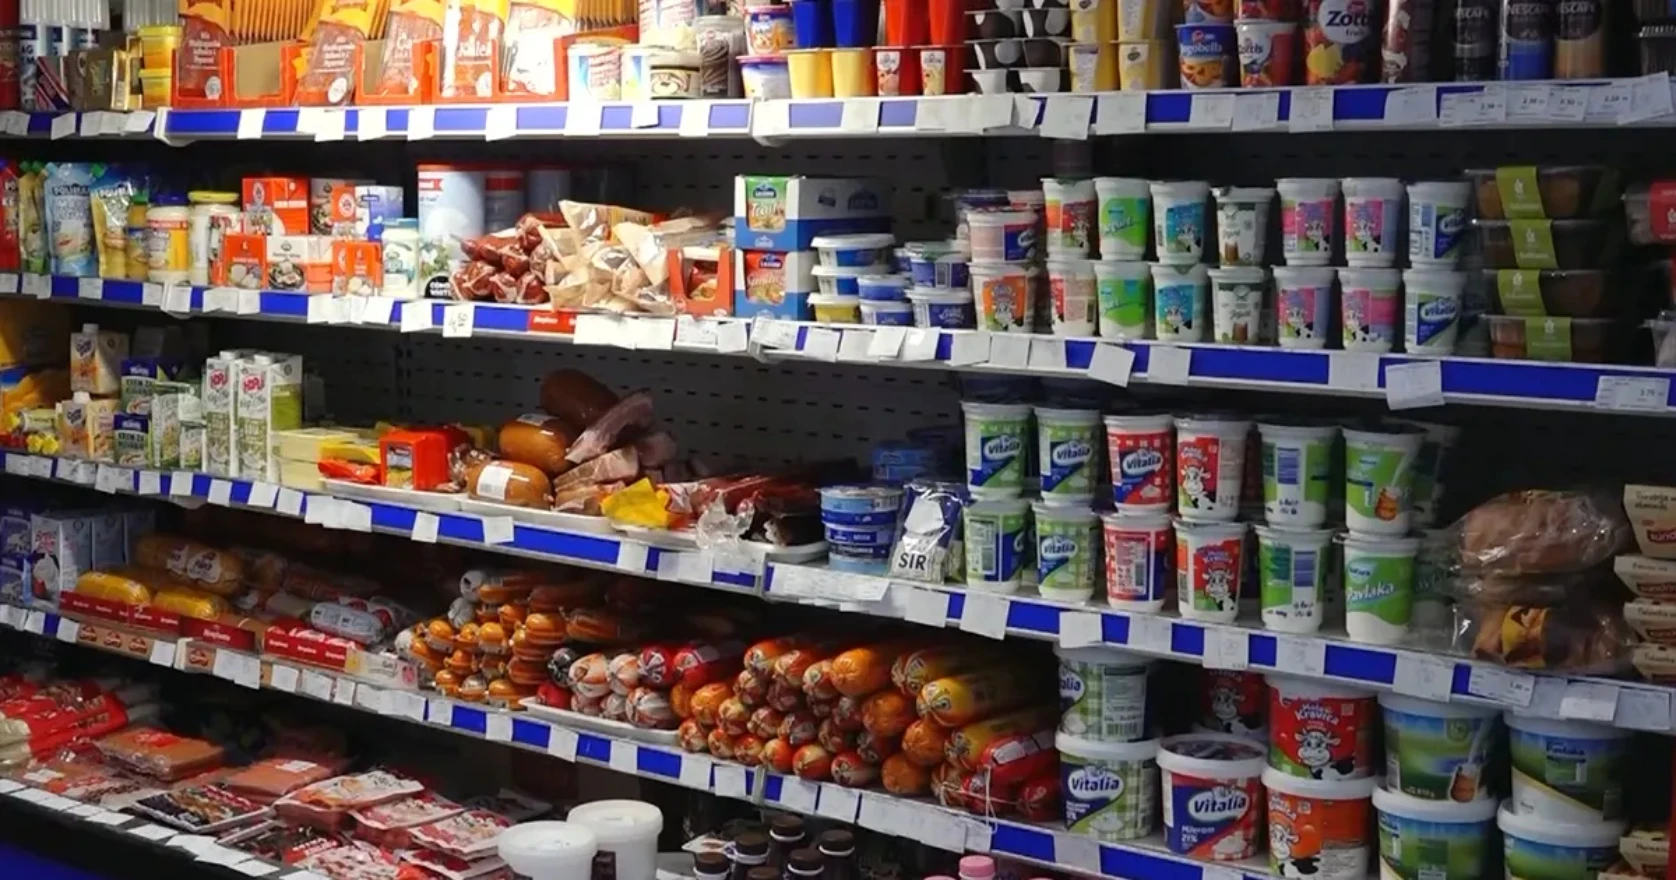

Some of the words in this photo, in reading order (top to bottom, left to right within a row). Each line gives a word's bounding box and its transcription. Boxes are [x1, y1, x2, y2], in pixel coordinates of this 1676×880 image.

[988, 439, 1021, 455] Vitalia
[1056, 446, 1091, 461] Vitalia
[1126, 454, 1162, 470] Vitalia
[1043, 540, 1076, 554] Vitalia
[898, 552, 927, 571] SIR
[1295, 709, 1340, 725] Kravica
[1071, 774, 1120, 792] Vitalia
[1193, 793, 1247, 814] Vitalia
